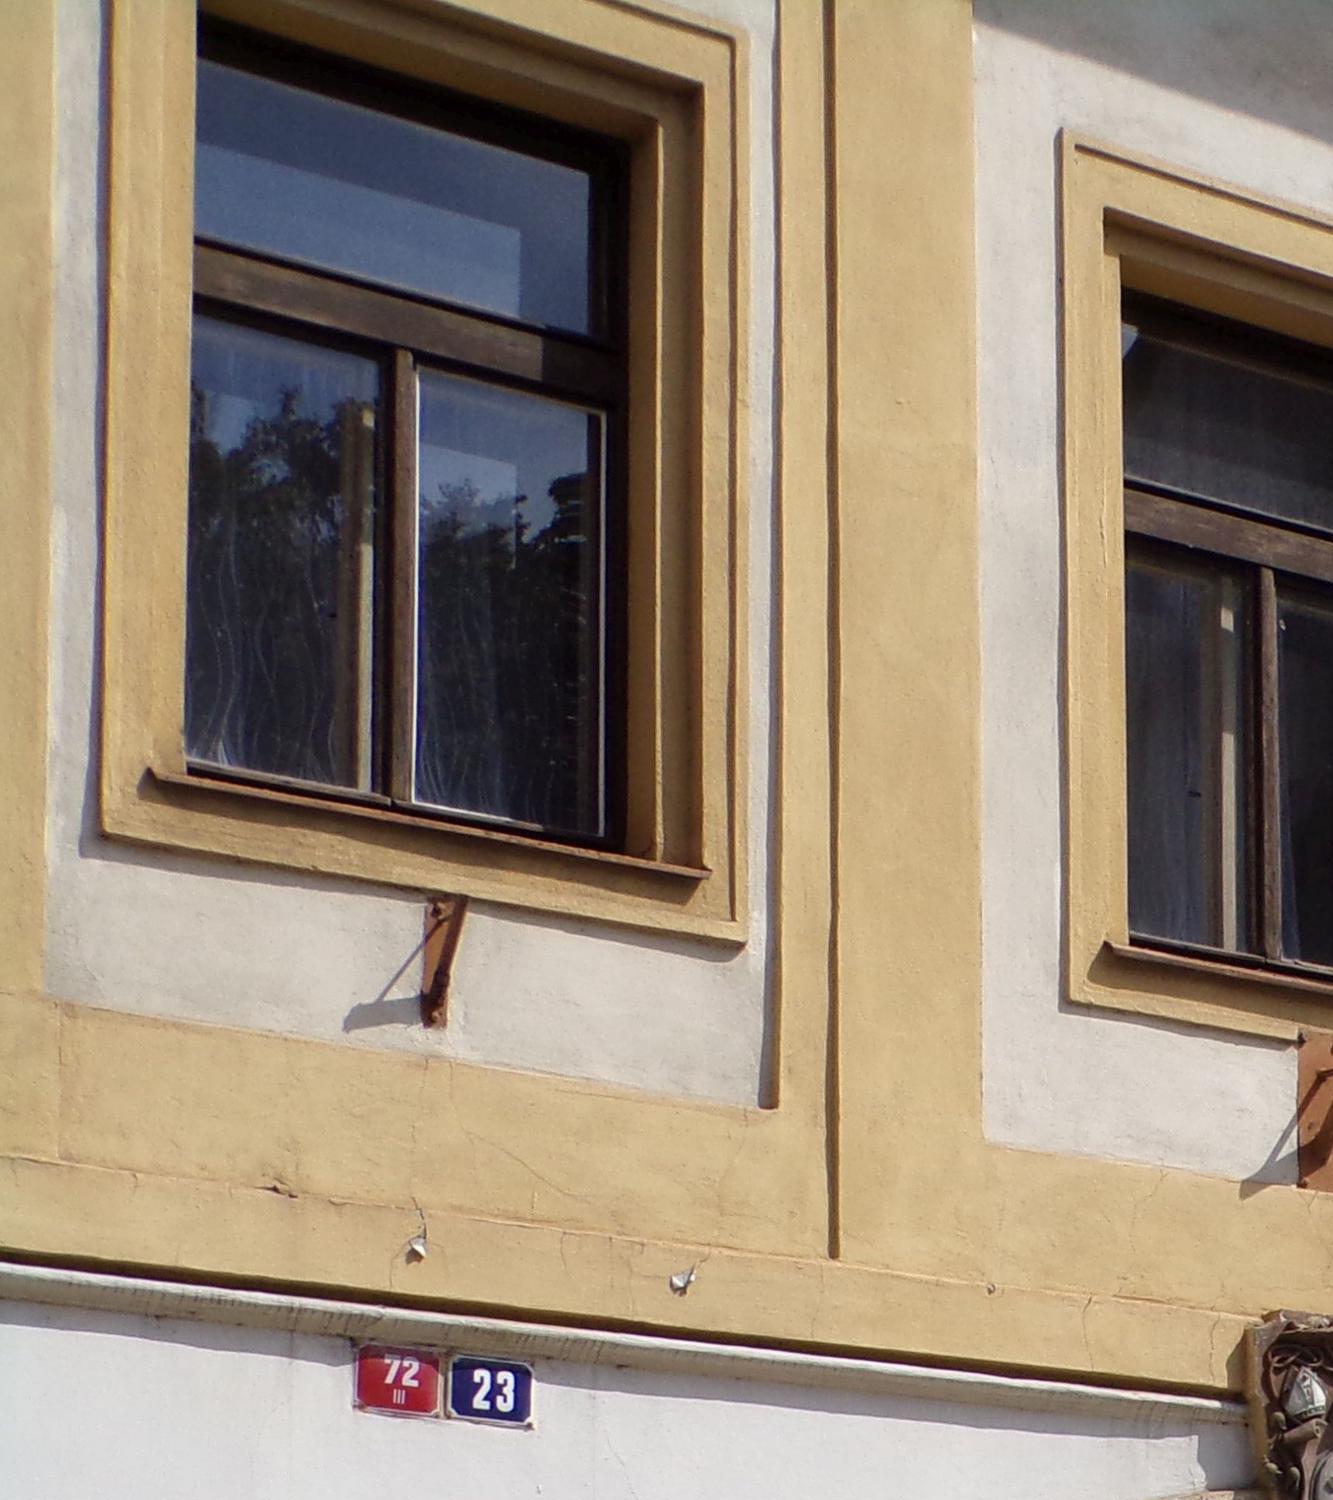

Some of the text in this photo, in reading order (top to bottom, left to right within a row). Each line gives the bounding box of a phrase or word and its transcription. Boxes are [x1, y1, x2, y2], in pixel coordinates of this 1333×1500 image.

[383, 1353, 420, 1388] 72
[392, 1388, 406, 1405] III
[472, 1368, 515, 1413] 23
